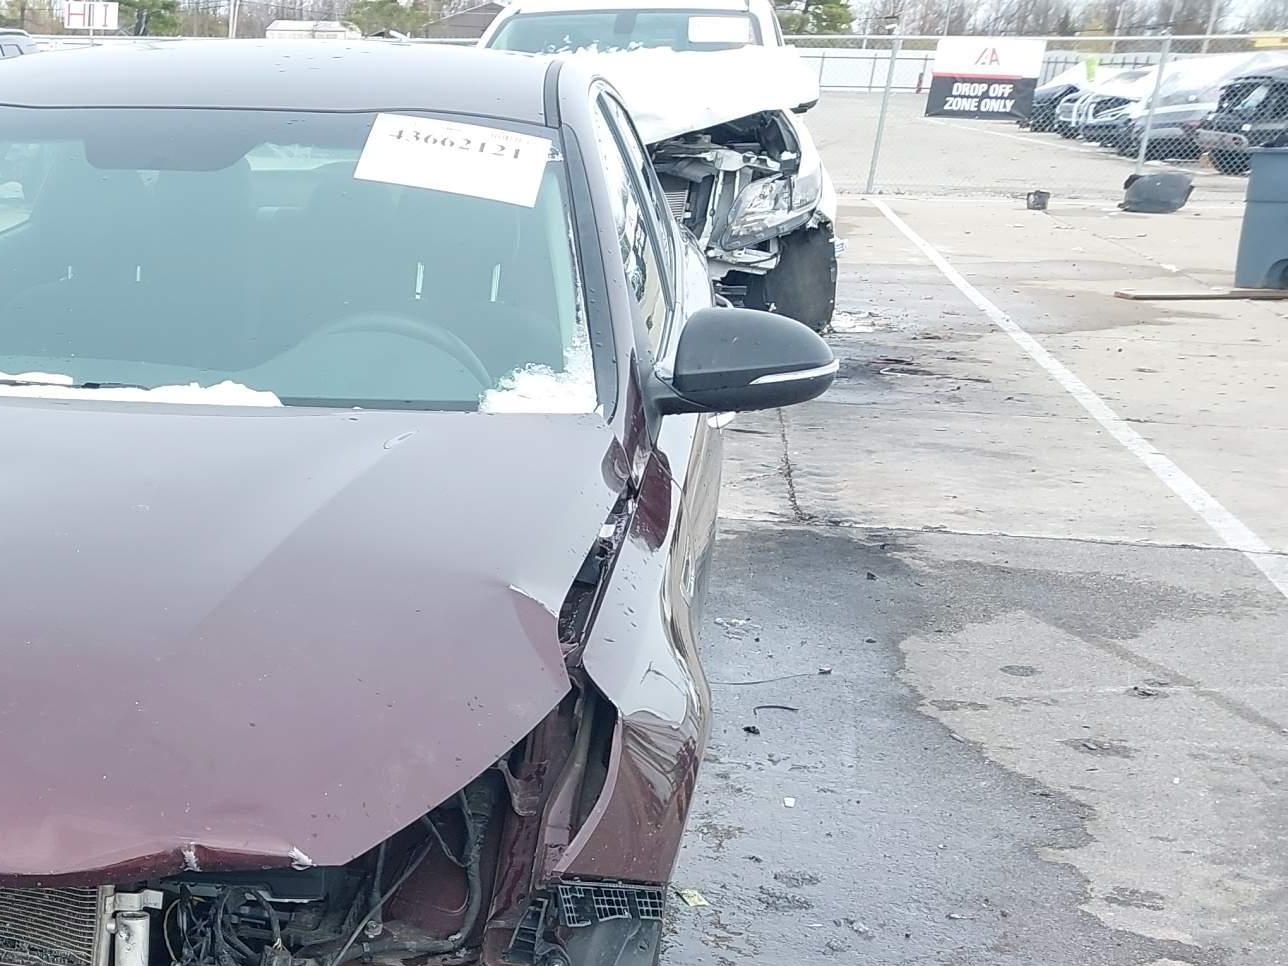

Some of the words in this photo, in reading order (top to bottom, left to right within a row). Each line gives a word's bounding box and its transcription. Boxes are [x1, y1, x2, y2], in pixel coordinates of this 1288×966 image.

[952, 82, 988, 96] DROP
[988, 84, 1014, 97] OFF
[943, 97, 979, 111] ZONE
[980, 99, 1016, 112] ONLY
[389, 129, 520, 159] 43662121
